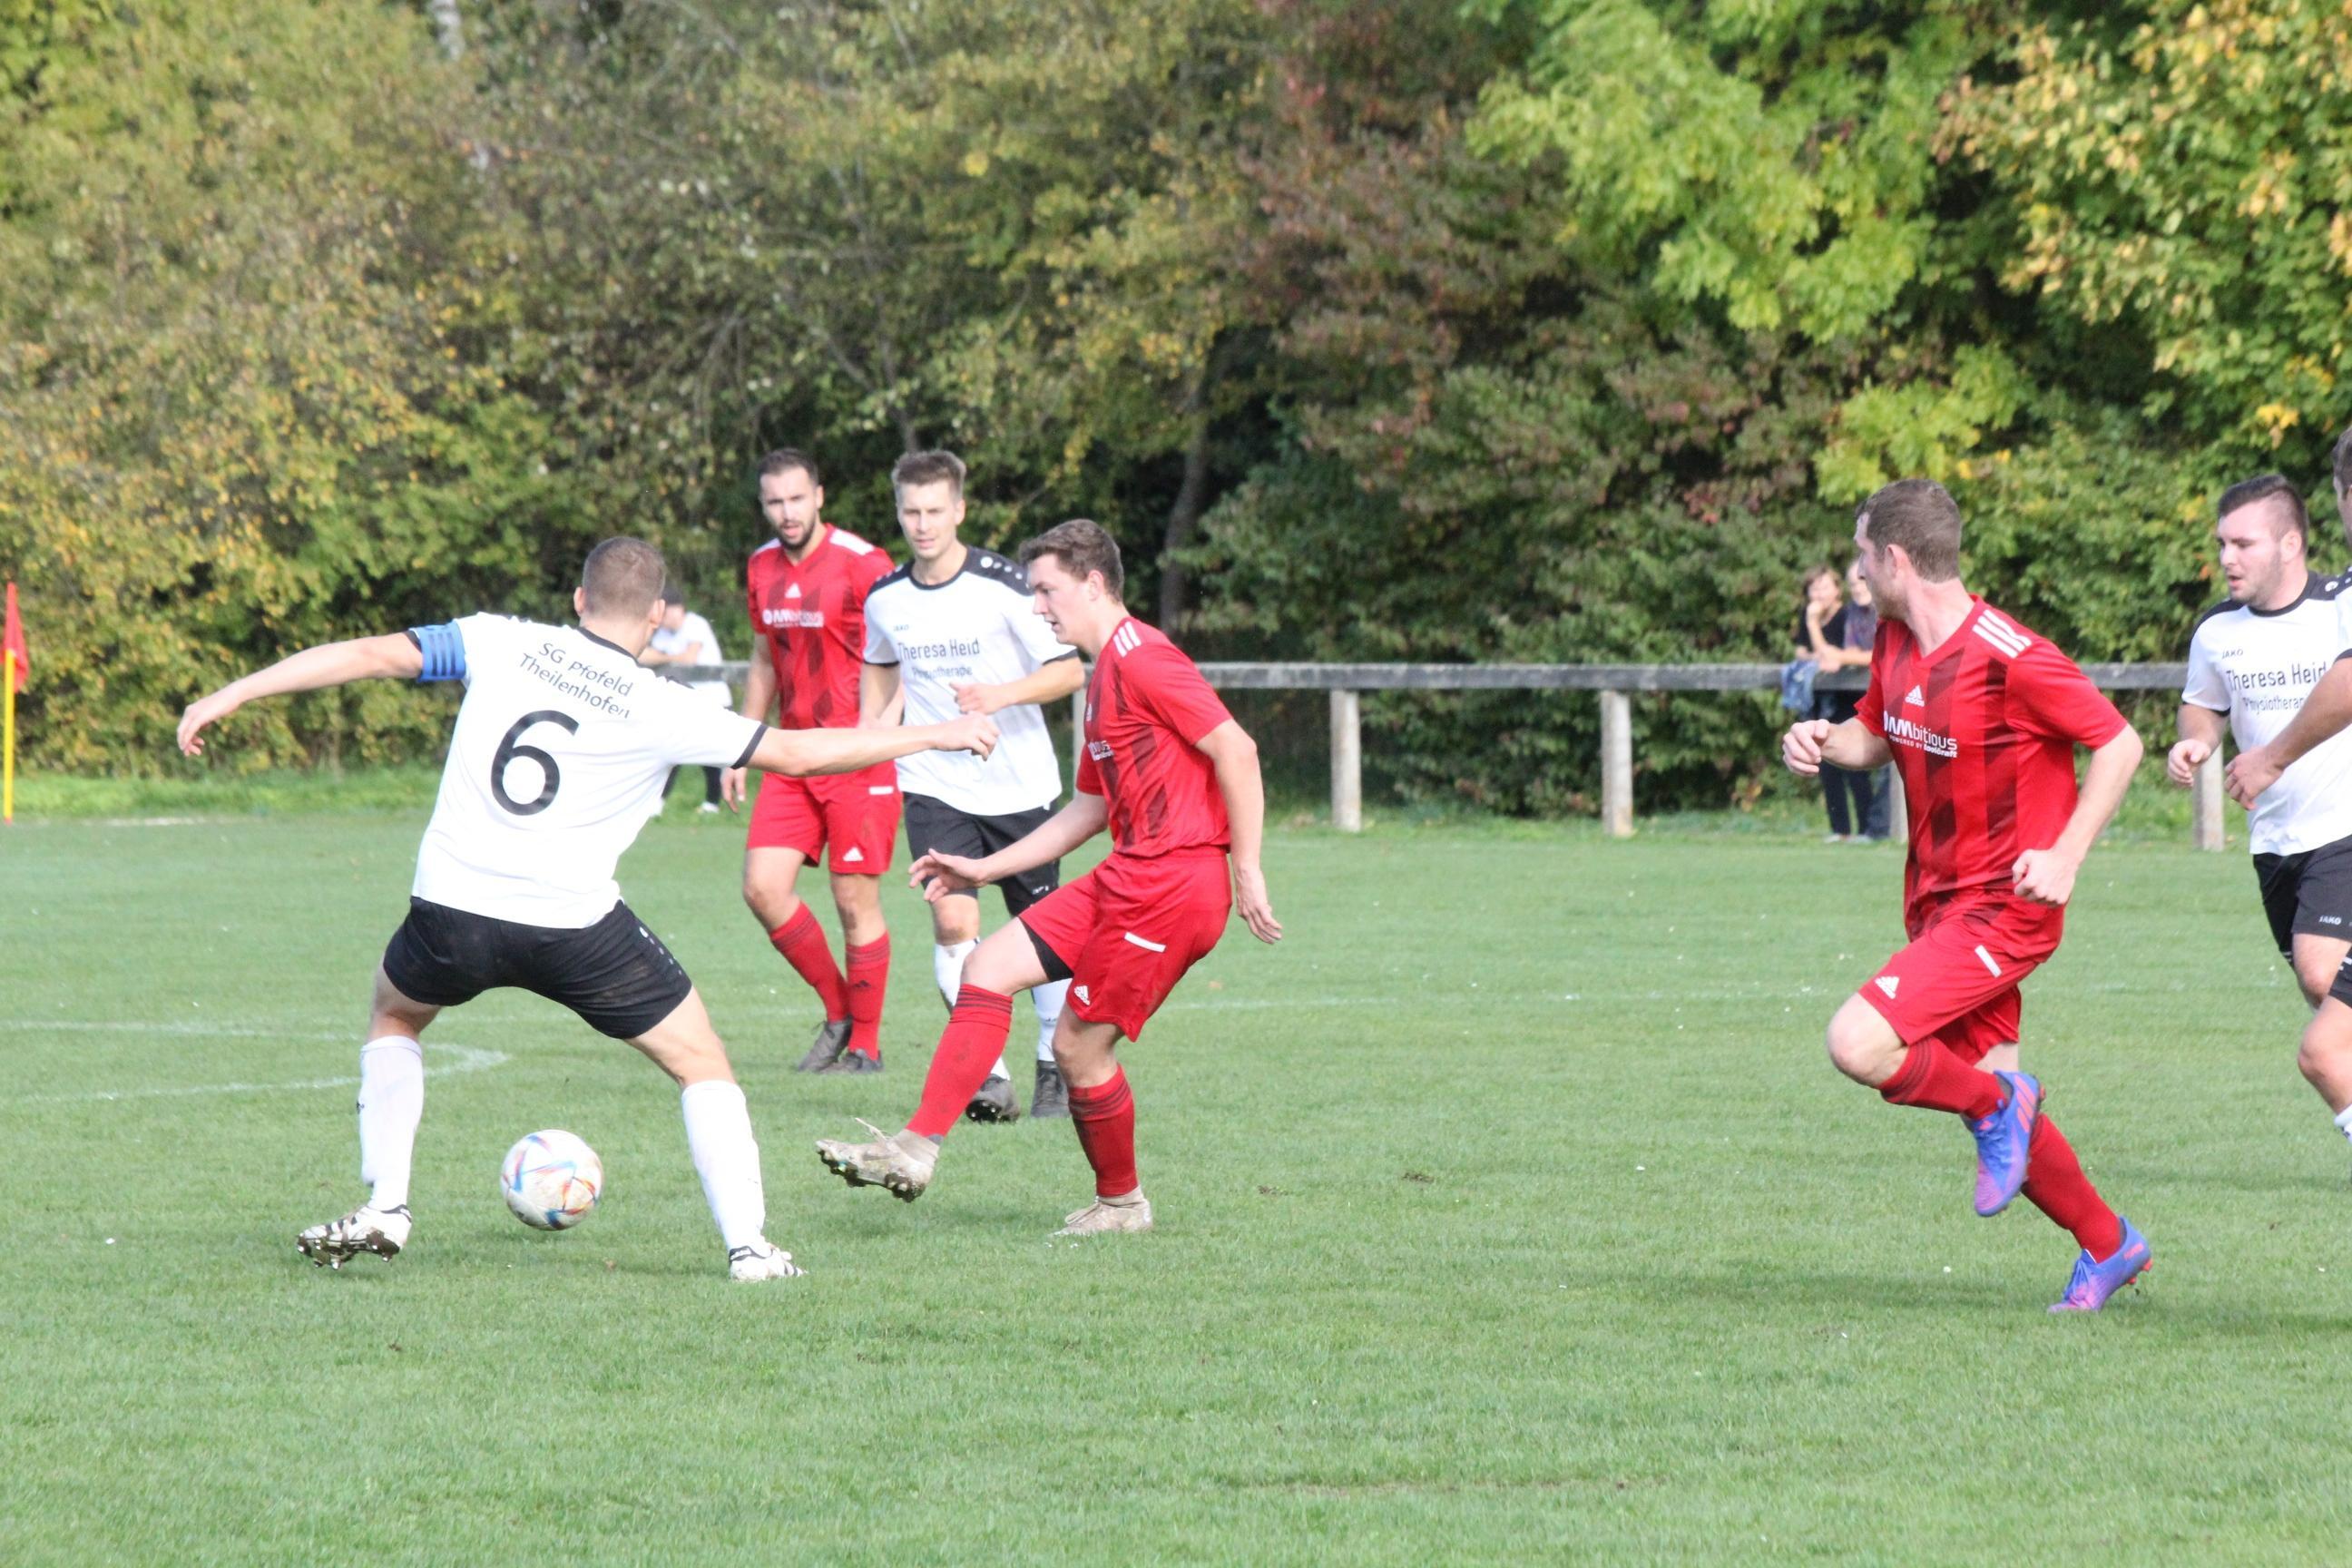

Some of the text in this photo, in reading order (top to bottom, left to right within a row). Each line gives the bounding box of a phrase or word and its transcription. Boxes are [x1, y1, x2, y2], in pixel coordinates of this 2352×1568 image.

[897, 637, 980, 660] Theresa Heid
[520, 652, 630, 719] Theilenhofen
[538, 642, 633, 697] SG Pfofeld
[2226, 669, 2287, 691] Theresa
[491, 710, 580, 817] 6
[2318, 915, 2342, 926] JAKO
